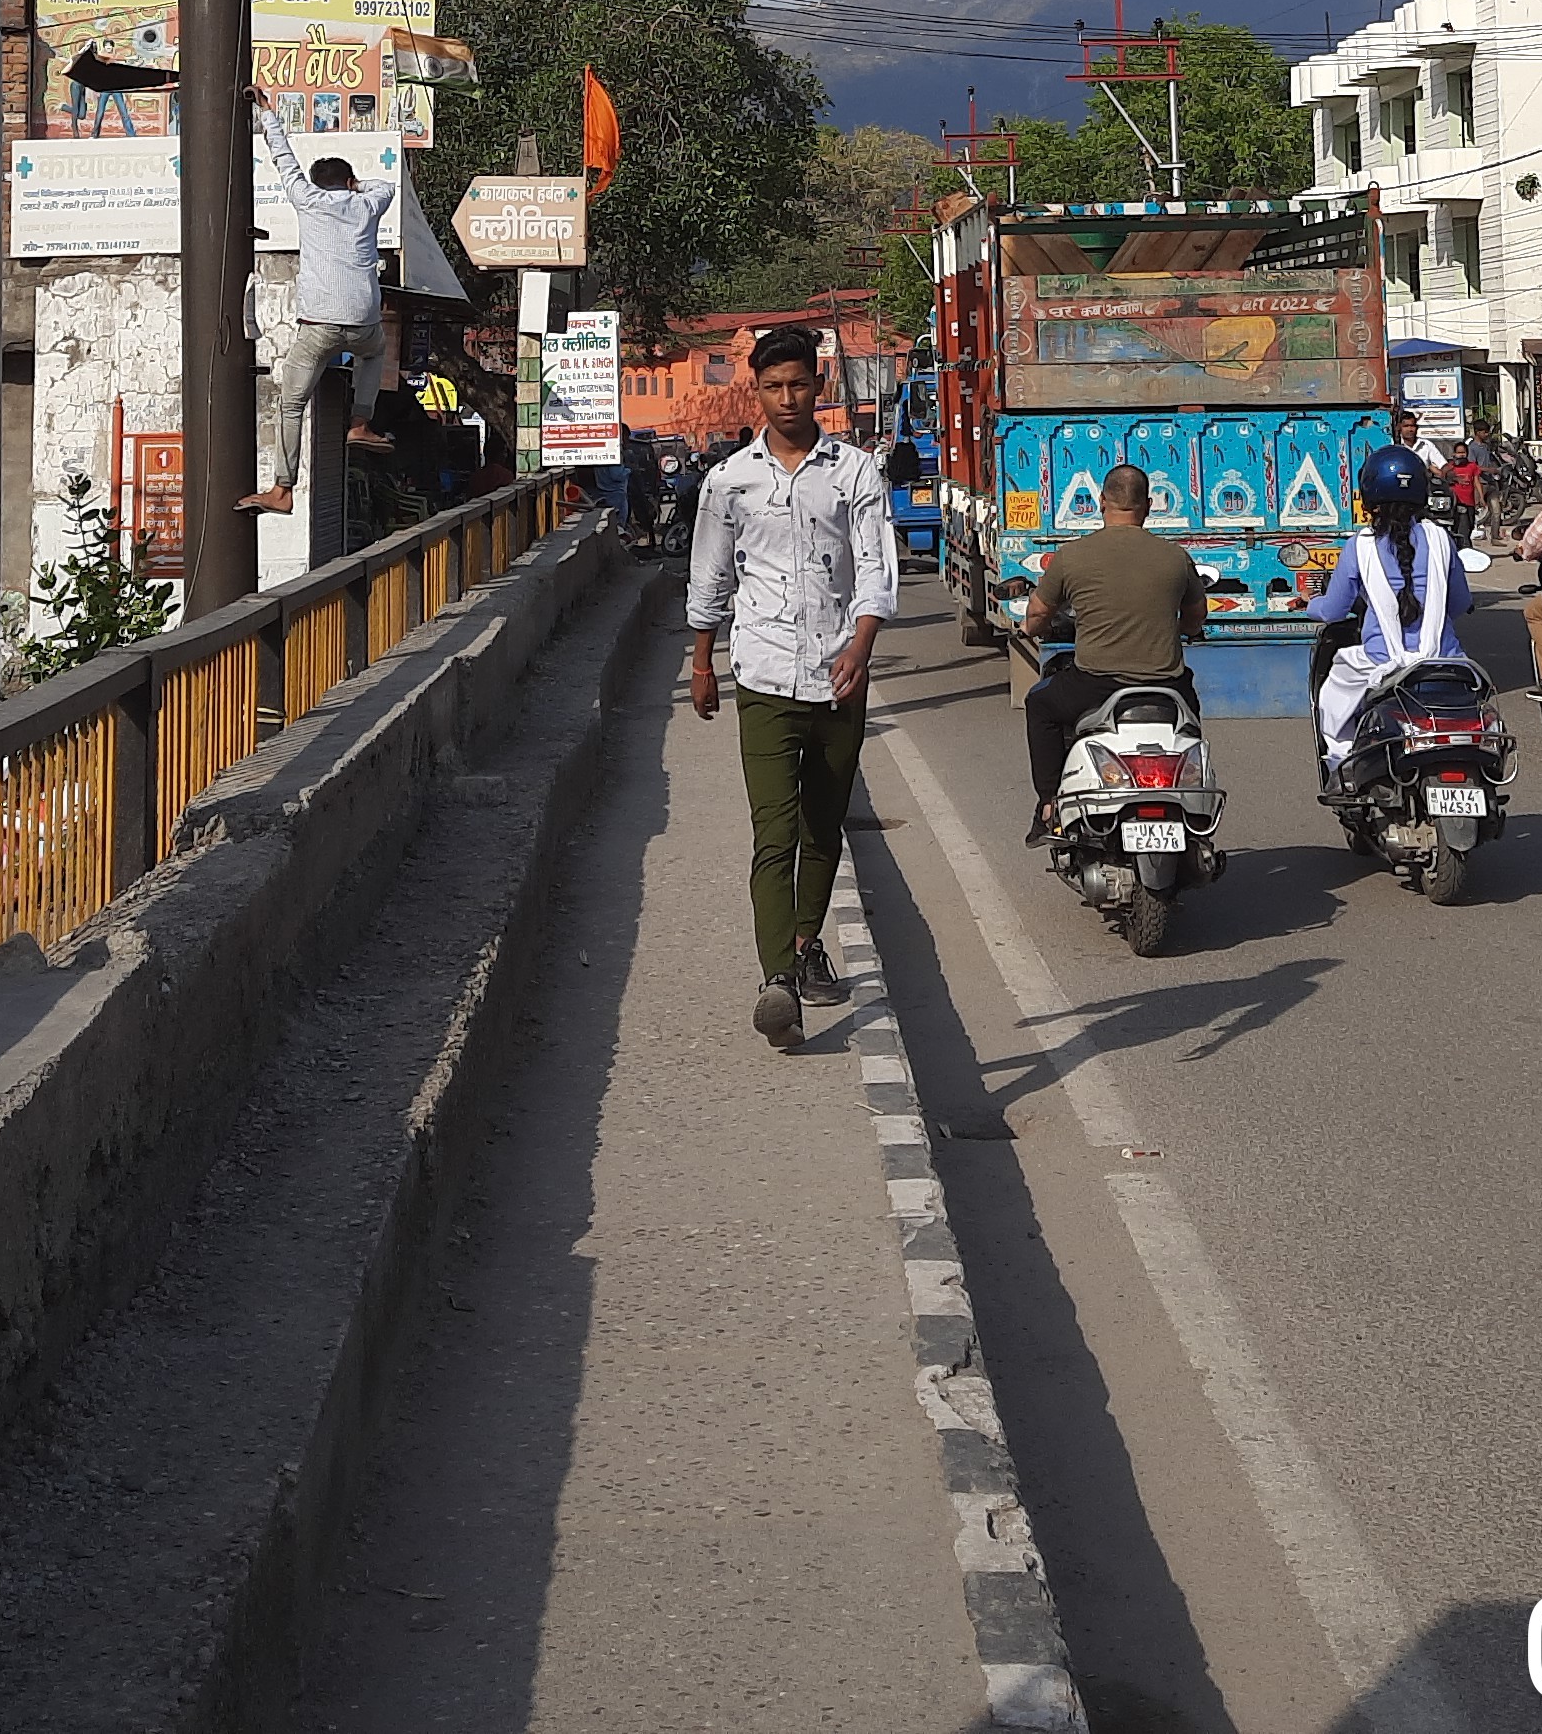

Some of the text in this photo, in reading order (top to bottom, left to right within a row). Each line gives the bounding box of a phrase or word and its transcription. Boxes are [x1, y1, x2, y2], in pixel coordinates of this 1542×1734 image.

[478, 185, 536, 202] कायाकल्प
[469, 204, 576, 242] क्लीनिक
[1270, 297, 1311, 312] 2022
[158, 450, 168, 468] 1
[1008, 510, 1036, 525] STOP
[1441, 789, 1475, 801] UK14
[1439, 801, 1479, 813] H4531
[1139, 824, 1175, 837] UK14
